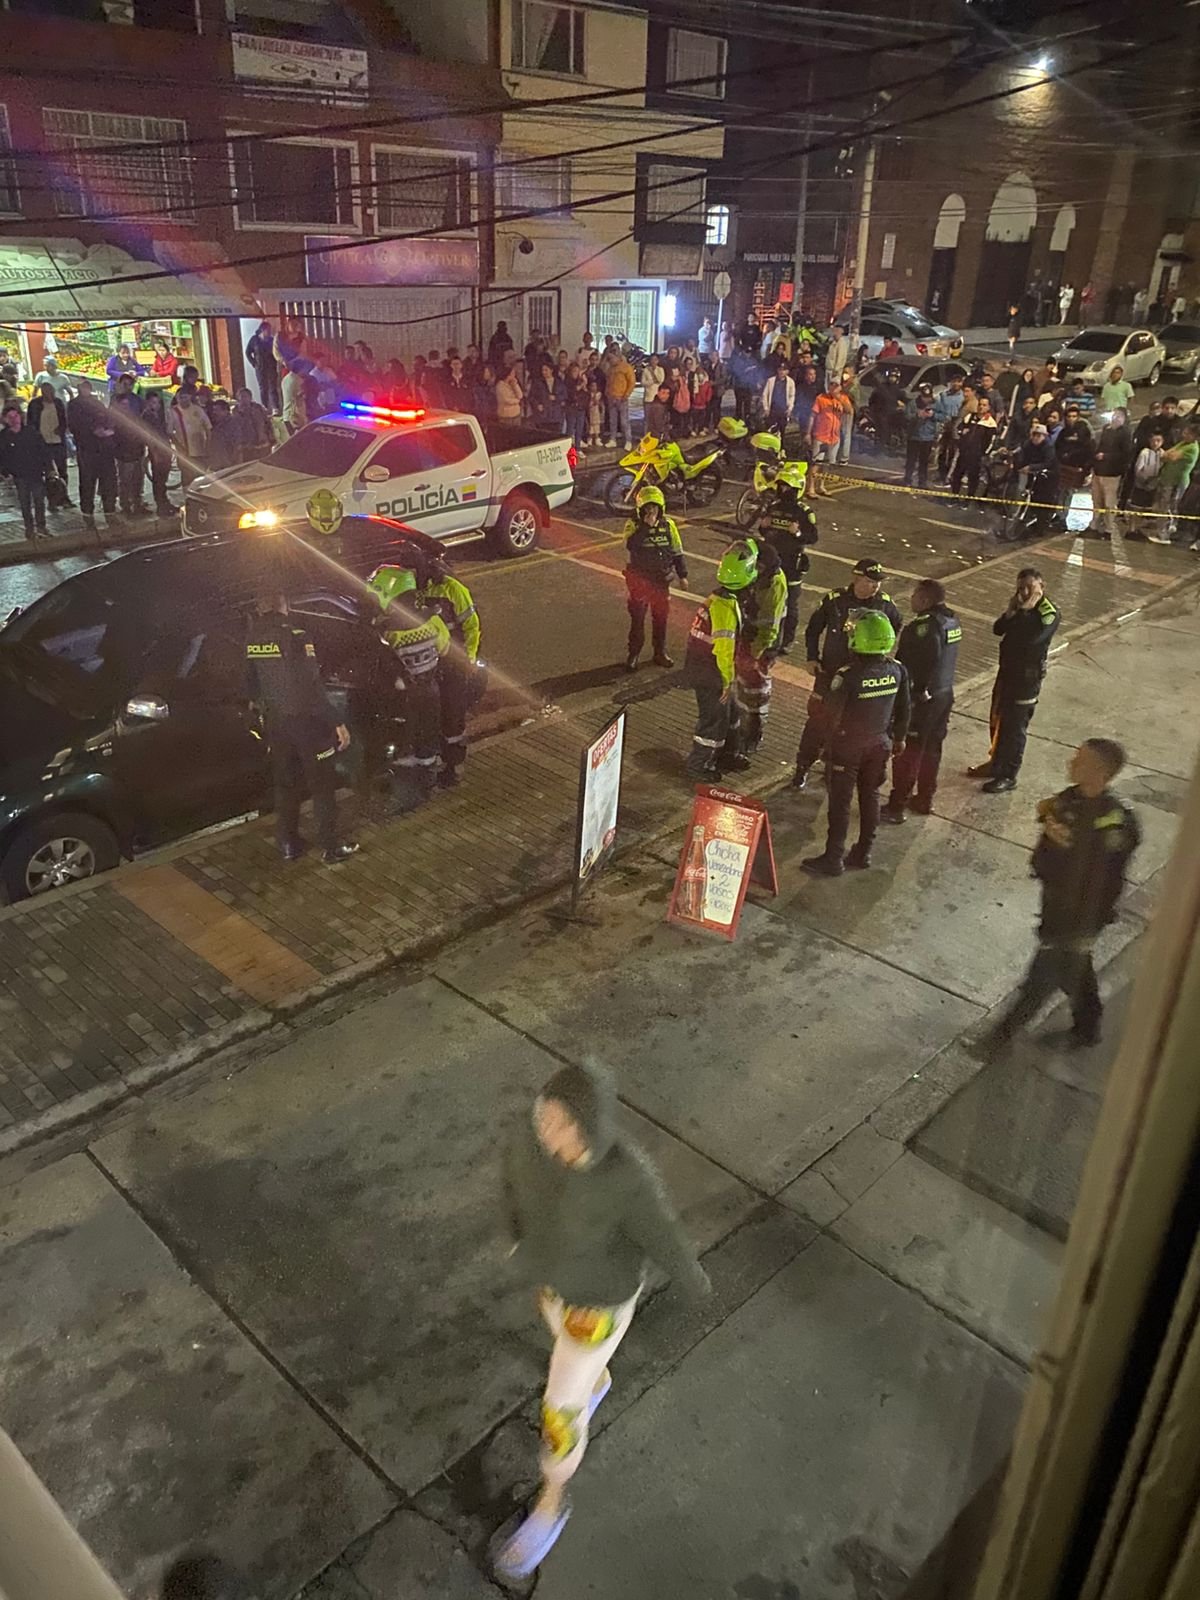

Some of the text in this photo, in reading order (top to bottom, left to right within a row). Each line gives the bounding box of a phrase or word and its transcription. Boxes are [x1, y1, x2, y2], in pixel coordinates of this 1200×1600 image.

[375, 483, 459, 517] POLICÍA
[247, 642, 280, 653] POLICÍA
[862, 675, 896, 688] POLICÍA
